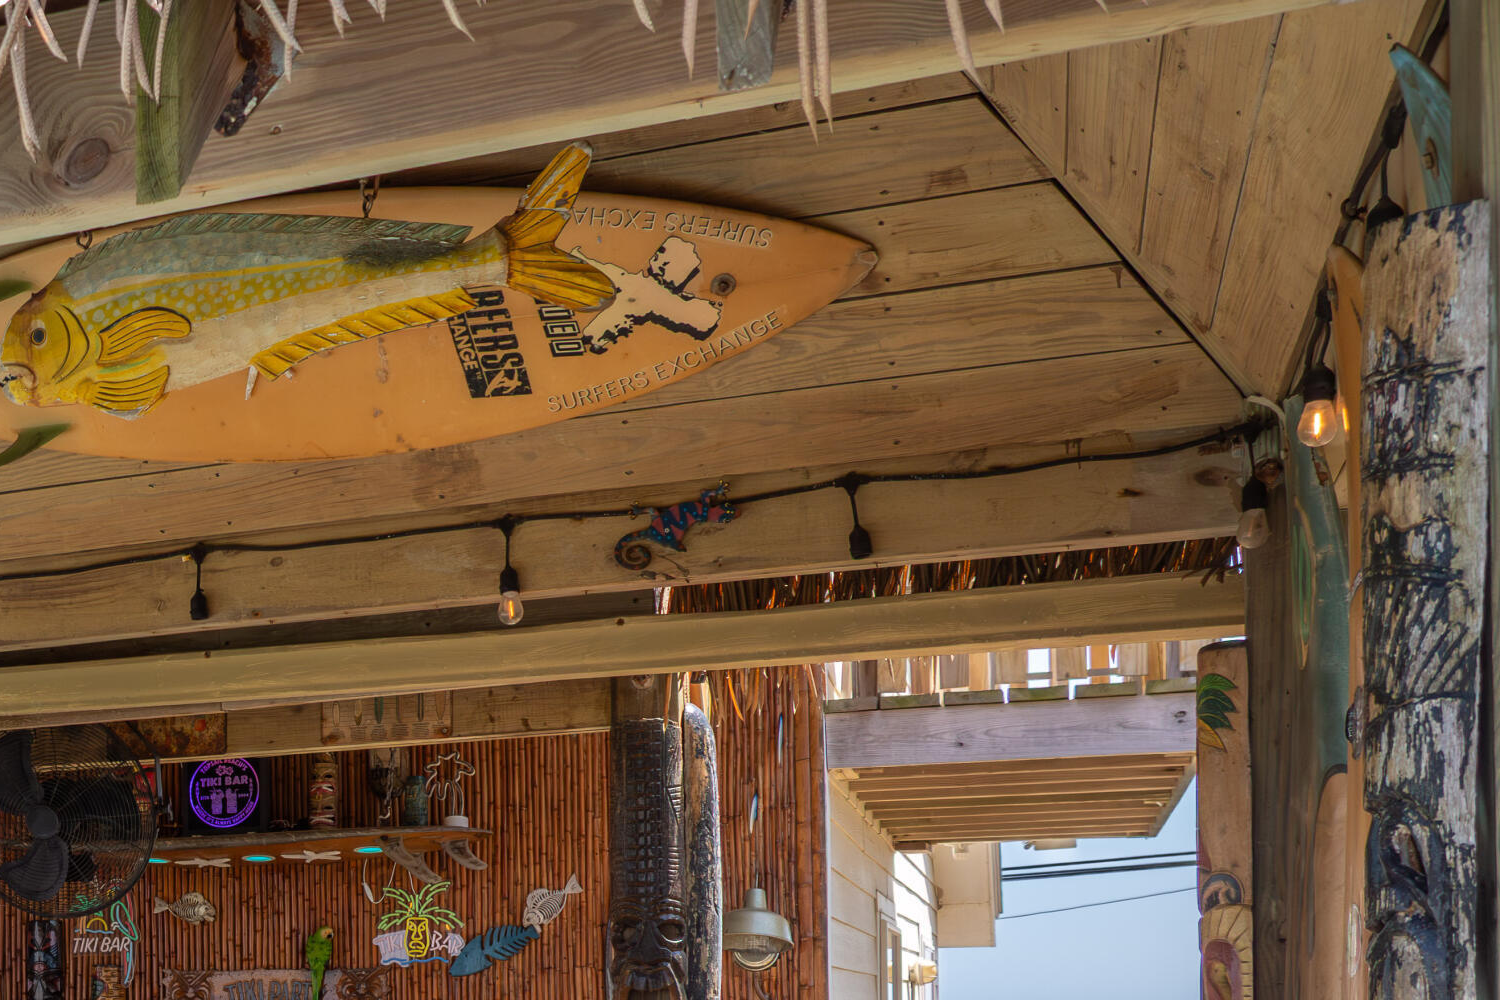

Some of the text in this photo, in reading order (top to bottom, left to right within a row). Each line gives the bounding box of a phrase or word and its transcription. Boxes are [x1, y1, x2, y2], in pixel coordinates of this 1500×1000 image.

[571, 207, 774, 248] SURFERS EXCHA
[449, 316, 478, 371] HANGE
[467, 290, 524, 369] RFERS
[547, 310, 784, 413] SURFERS EXCHANGE
[200, 775, 249, 788] TIKI BAR
[73, 936, 131, 953] TIKI BAR
[372, 930, 465, 955] TIKI BAR
